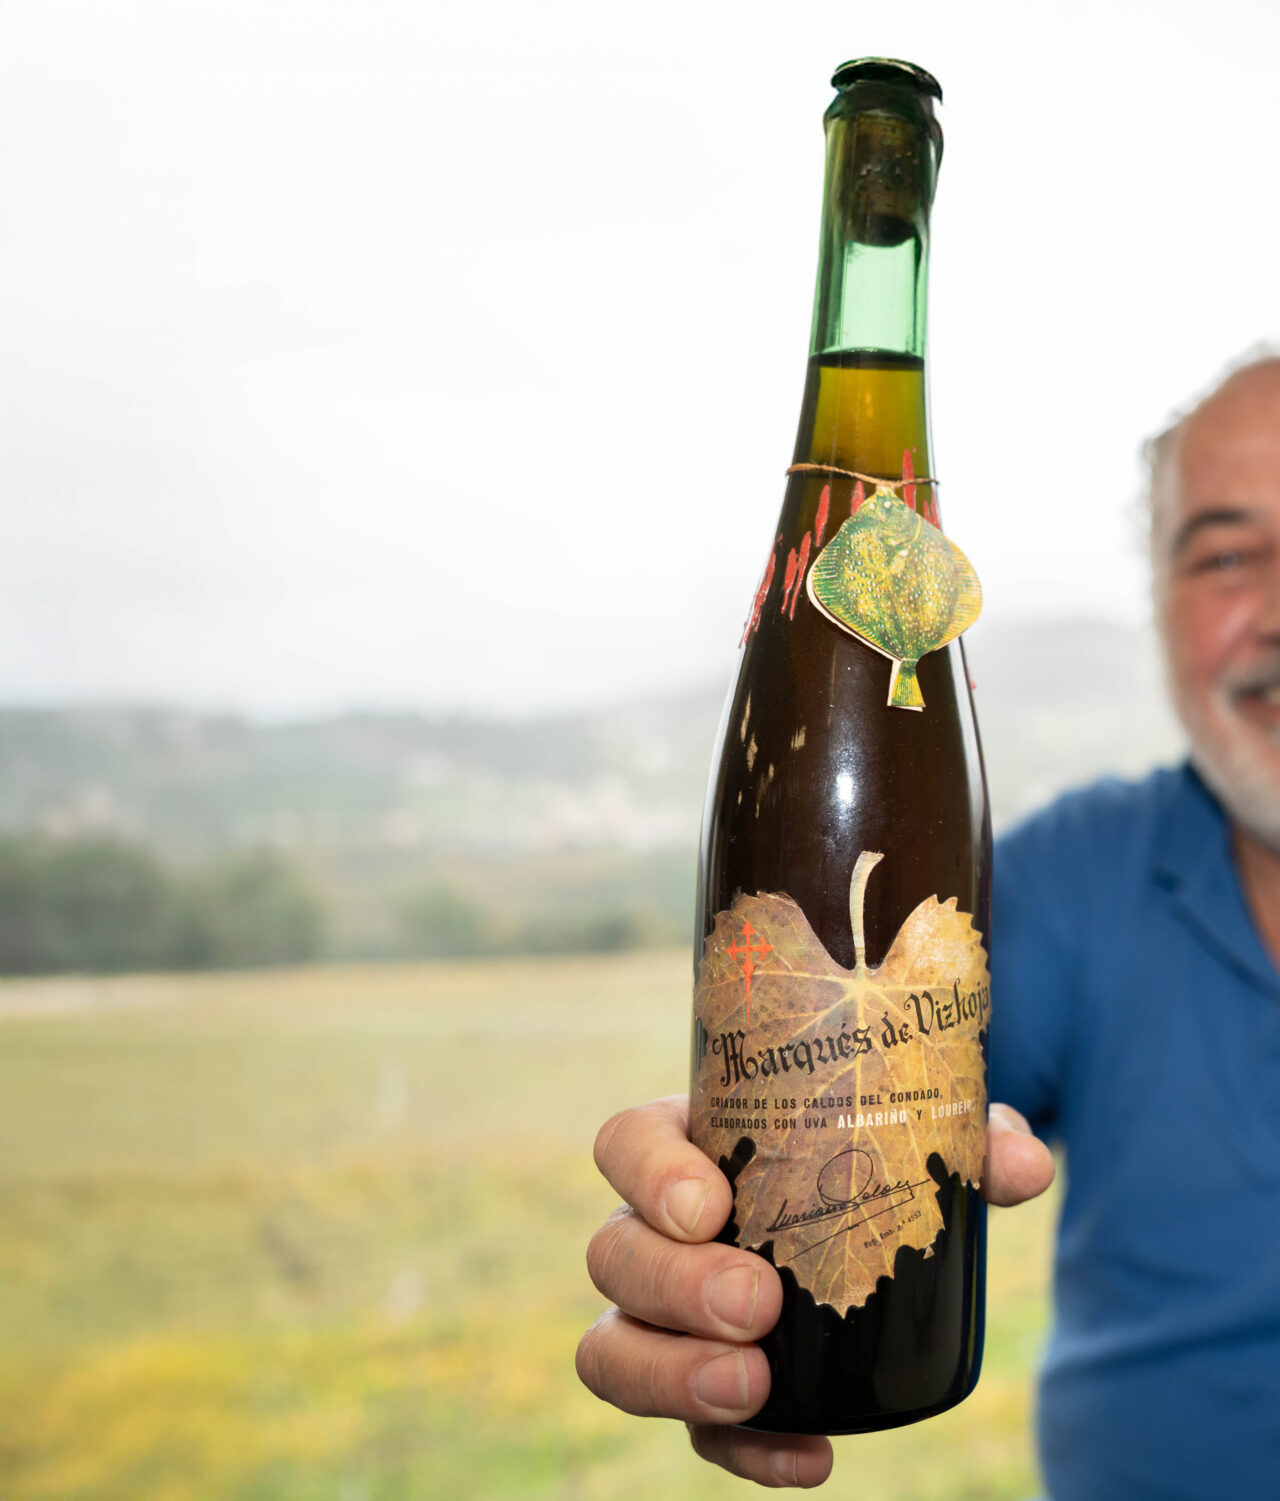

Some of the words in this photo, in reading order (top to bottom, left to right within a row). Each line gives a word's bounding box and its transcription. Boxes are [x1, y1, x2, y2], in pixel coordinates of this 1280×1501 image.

[712, 1023, 873, 1087] Marqués
[881, 1011, 913, 1049] de
[904, 977, 988, 1035] Vizhoja
[710, 1097, 748, 1109] CRIADOR
[754, 1099, 768, 1110] DE
[774, 1098, 797, 1109] LOS
[803, 1096, 852, 1109] CALDOS
[860, 1094, 883, 1106] DEL
[889, 1087, 943, 1104] CONDADO,
[711, 1116, 767, 1129] ELABORADOS
[774, 1118, 797, 1129] CON
[804, 1117, 827, 1129] UVA
[837, 1108, 907, 1129] ALBARIÑO
[916, 1109, 923, 1120] Y
